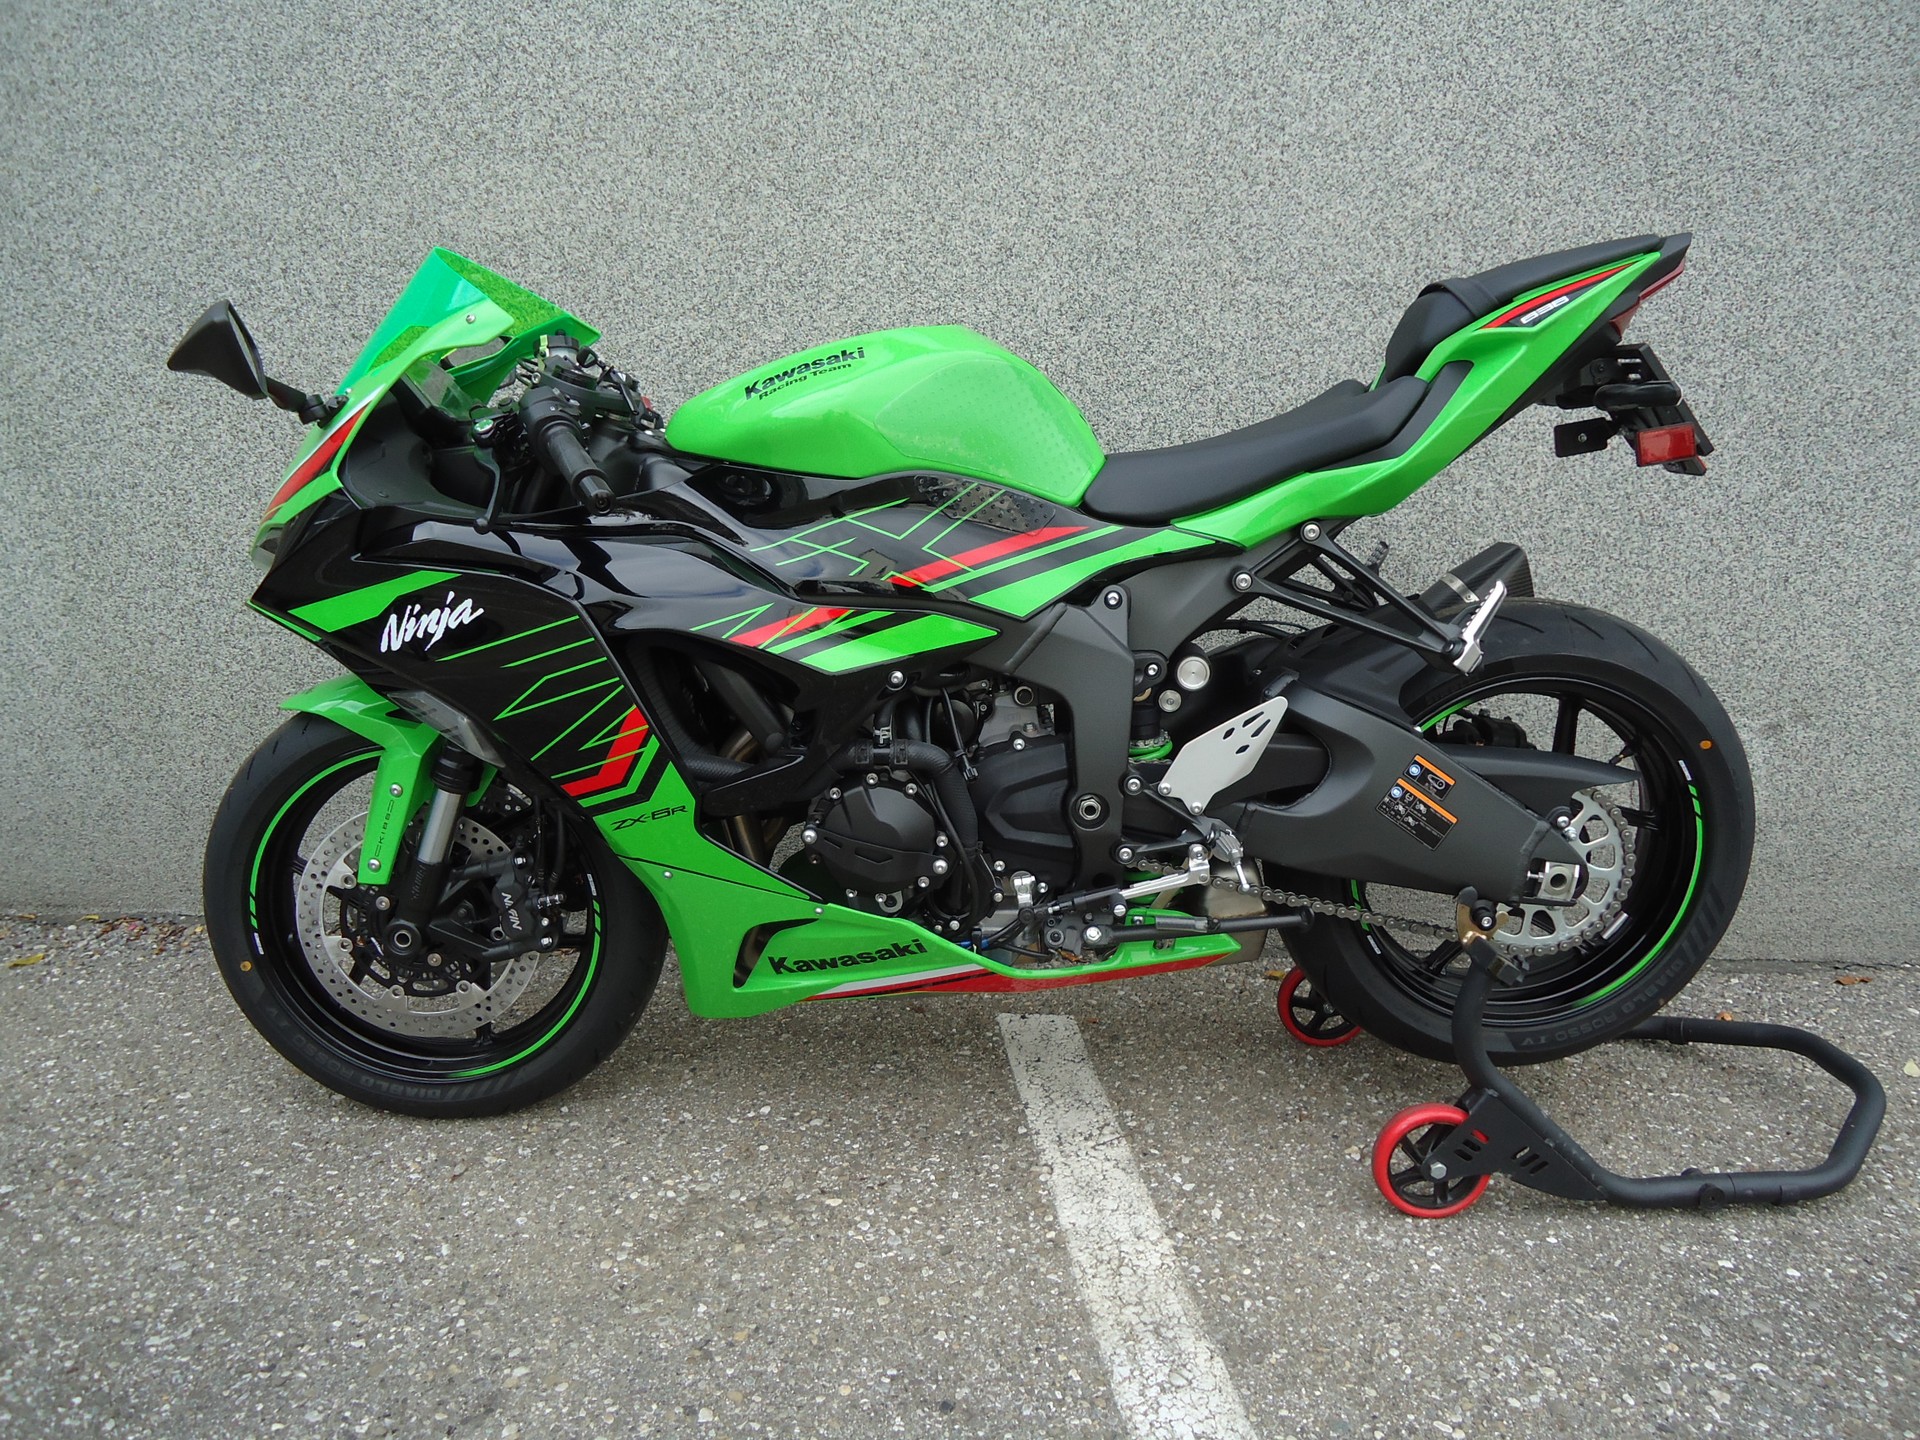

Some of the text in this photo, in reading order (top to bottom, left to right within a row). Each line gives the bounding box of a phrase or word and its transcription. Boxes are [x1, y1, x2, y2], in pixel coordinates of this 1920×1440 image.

[744, 346, 866, 401] Kawasaki
[758, 363, 852, 401] Racing Team
[380, 590, 485, 653] Ninja
[610, 805, 688, 831] ZX-6R
[768, 938, 928, 975] Kawasaki
[1554, 1013, 1617, 1041] ROSSO
